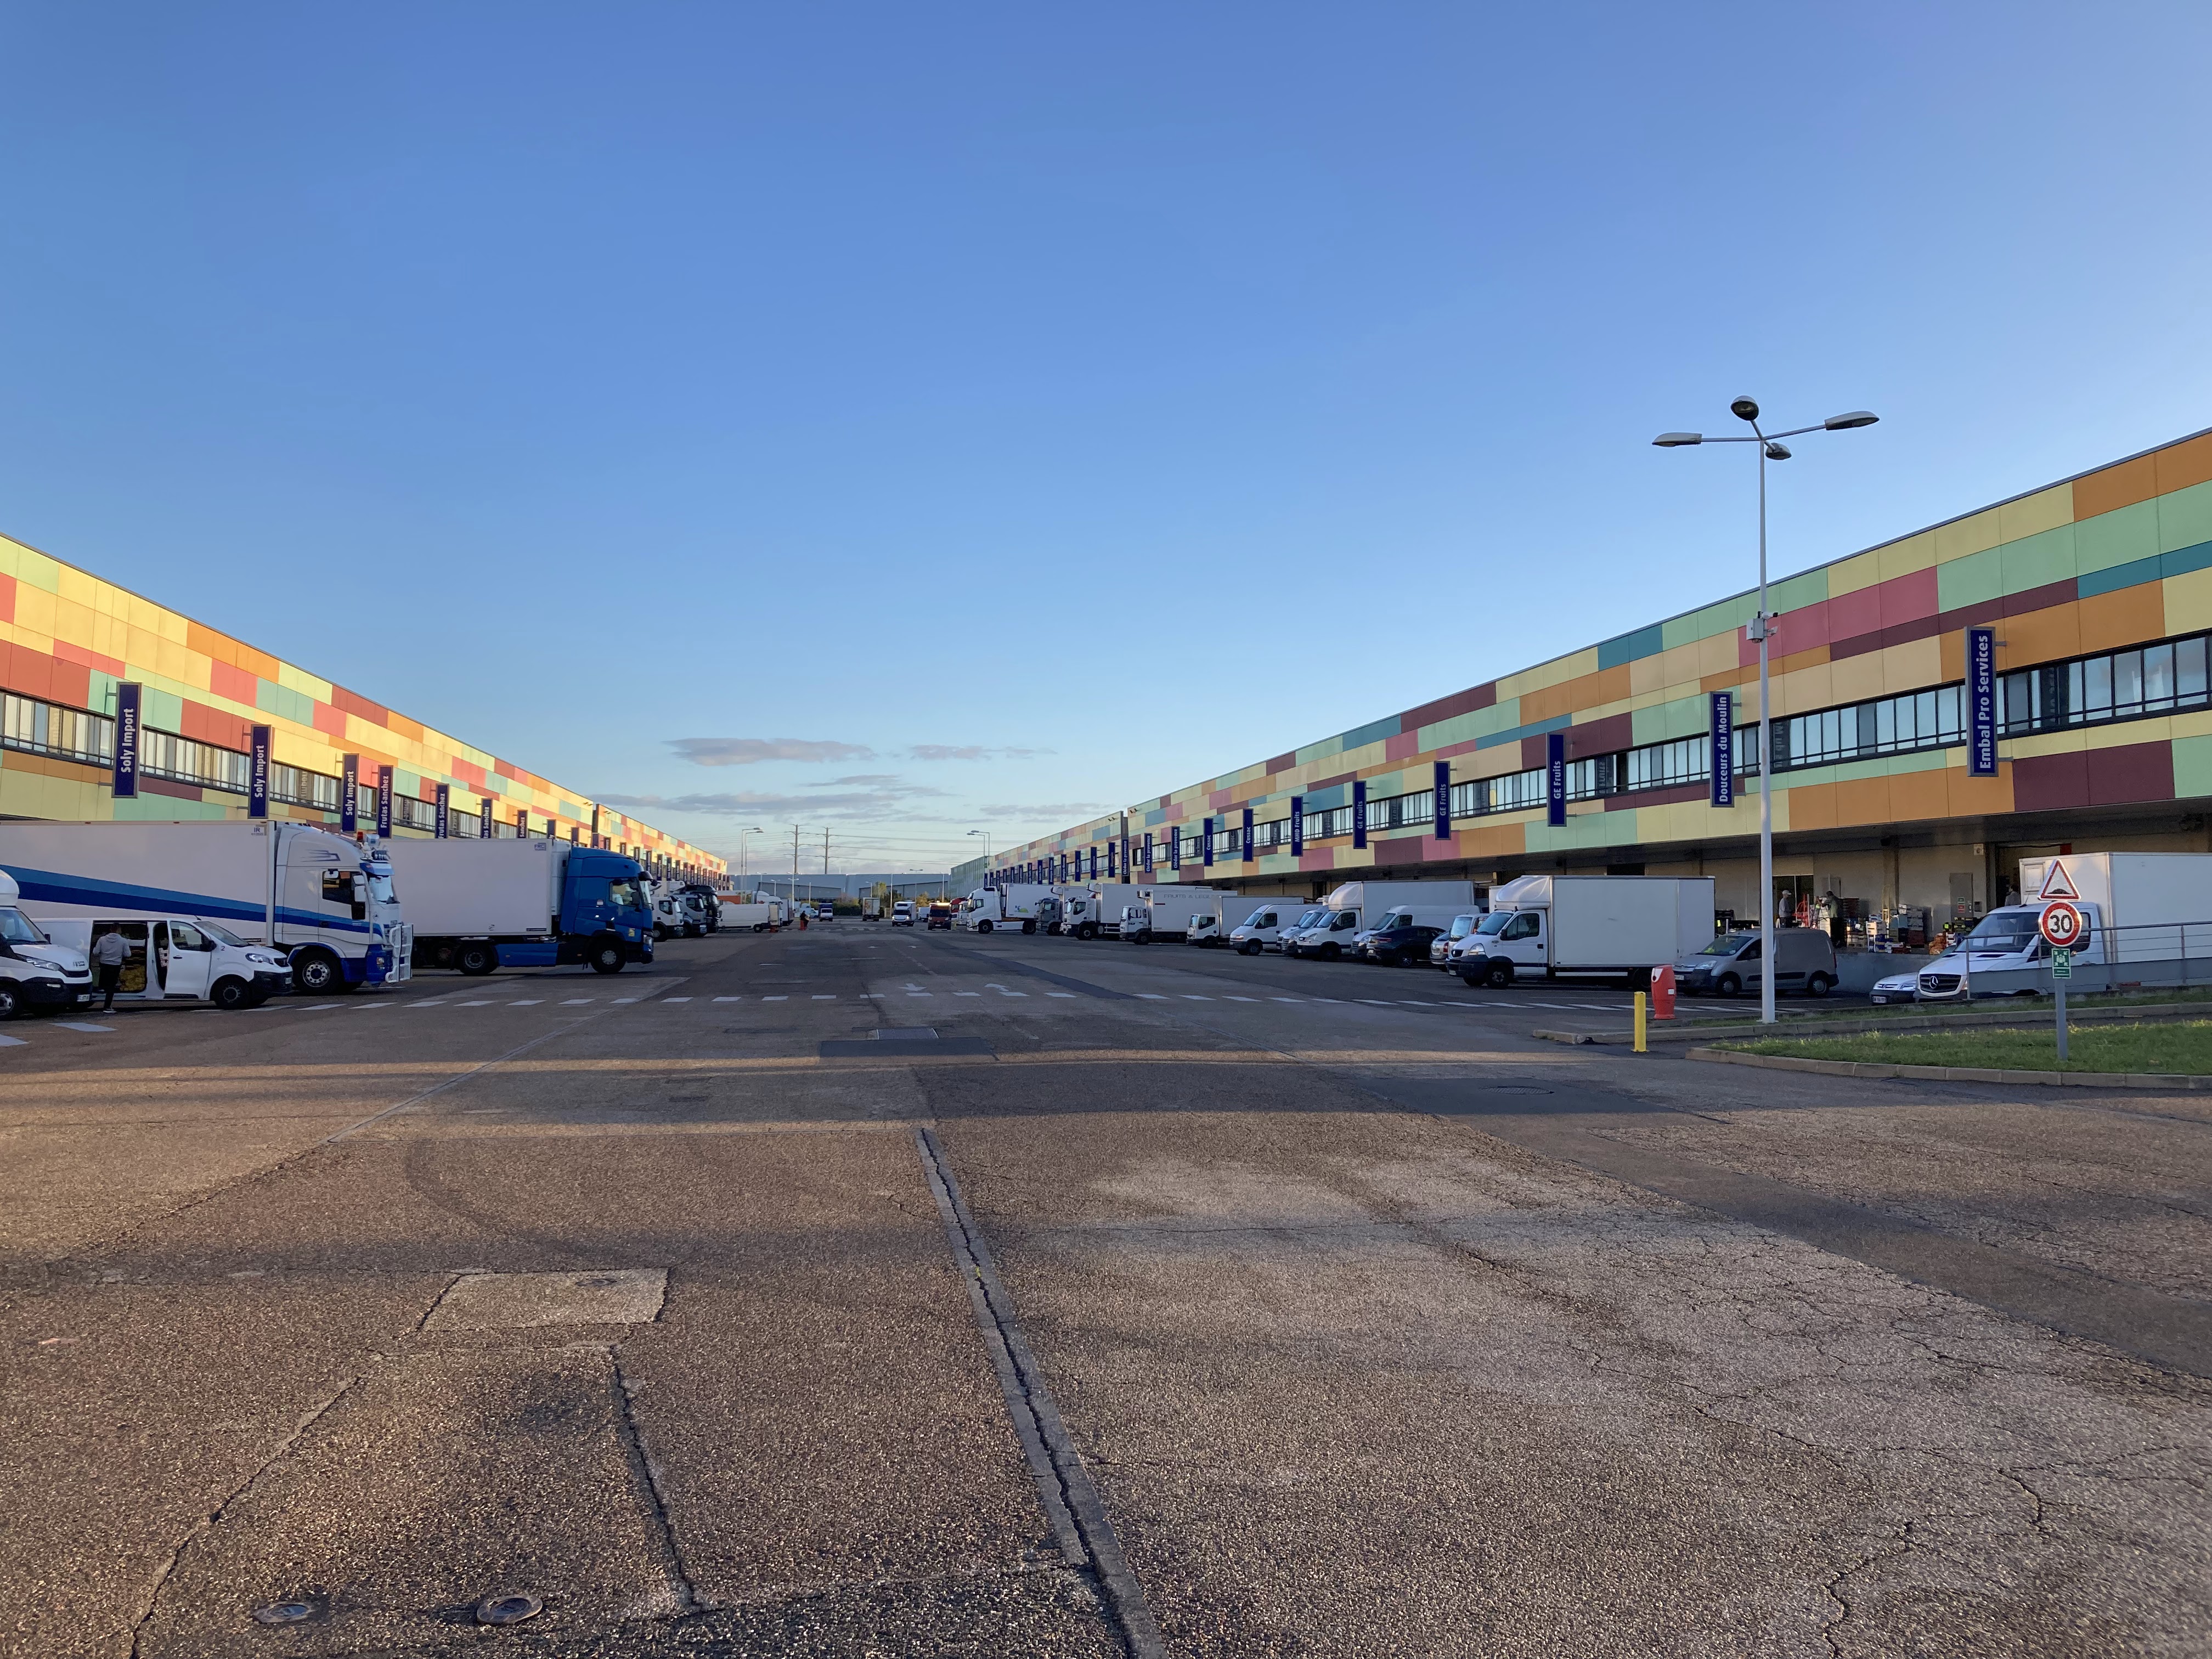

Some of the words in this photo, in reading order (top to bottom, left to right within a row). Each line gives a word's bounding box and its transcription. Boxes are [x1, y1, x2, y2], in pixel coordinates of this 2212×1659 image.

[1976, 635, 1989, 693] Services
[1717, 697, 1728, 733] Moulin
[1978, 697, 1989, 721] Pro
[122, 708, 136, 747] Import
[1718, 736, 1728, 751] du
[1978, 725, 1990, 769] Embal
[120, 749, 134, 773] Soly
[255, 745, 266, 776] Import
[346, 771, 355, 798] Import
[1553, 761, 1561, 786] Fruits
[1719, 754, 1728, 802] Douceurs
[254, 778, 266, 798] Soly
[381, 776, 389, 805] Sanchez
[1553, 788, 1561, 799] GE
[345, 799, 355, 816] Soly
[1440, 807, 1446, 816] GE
[1357, 821, 1363, 829] GE
[2050, 915, 2073, 933] 30
